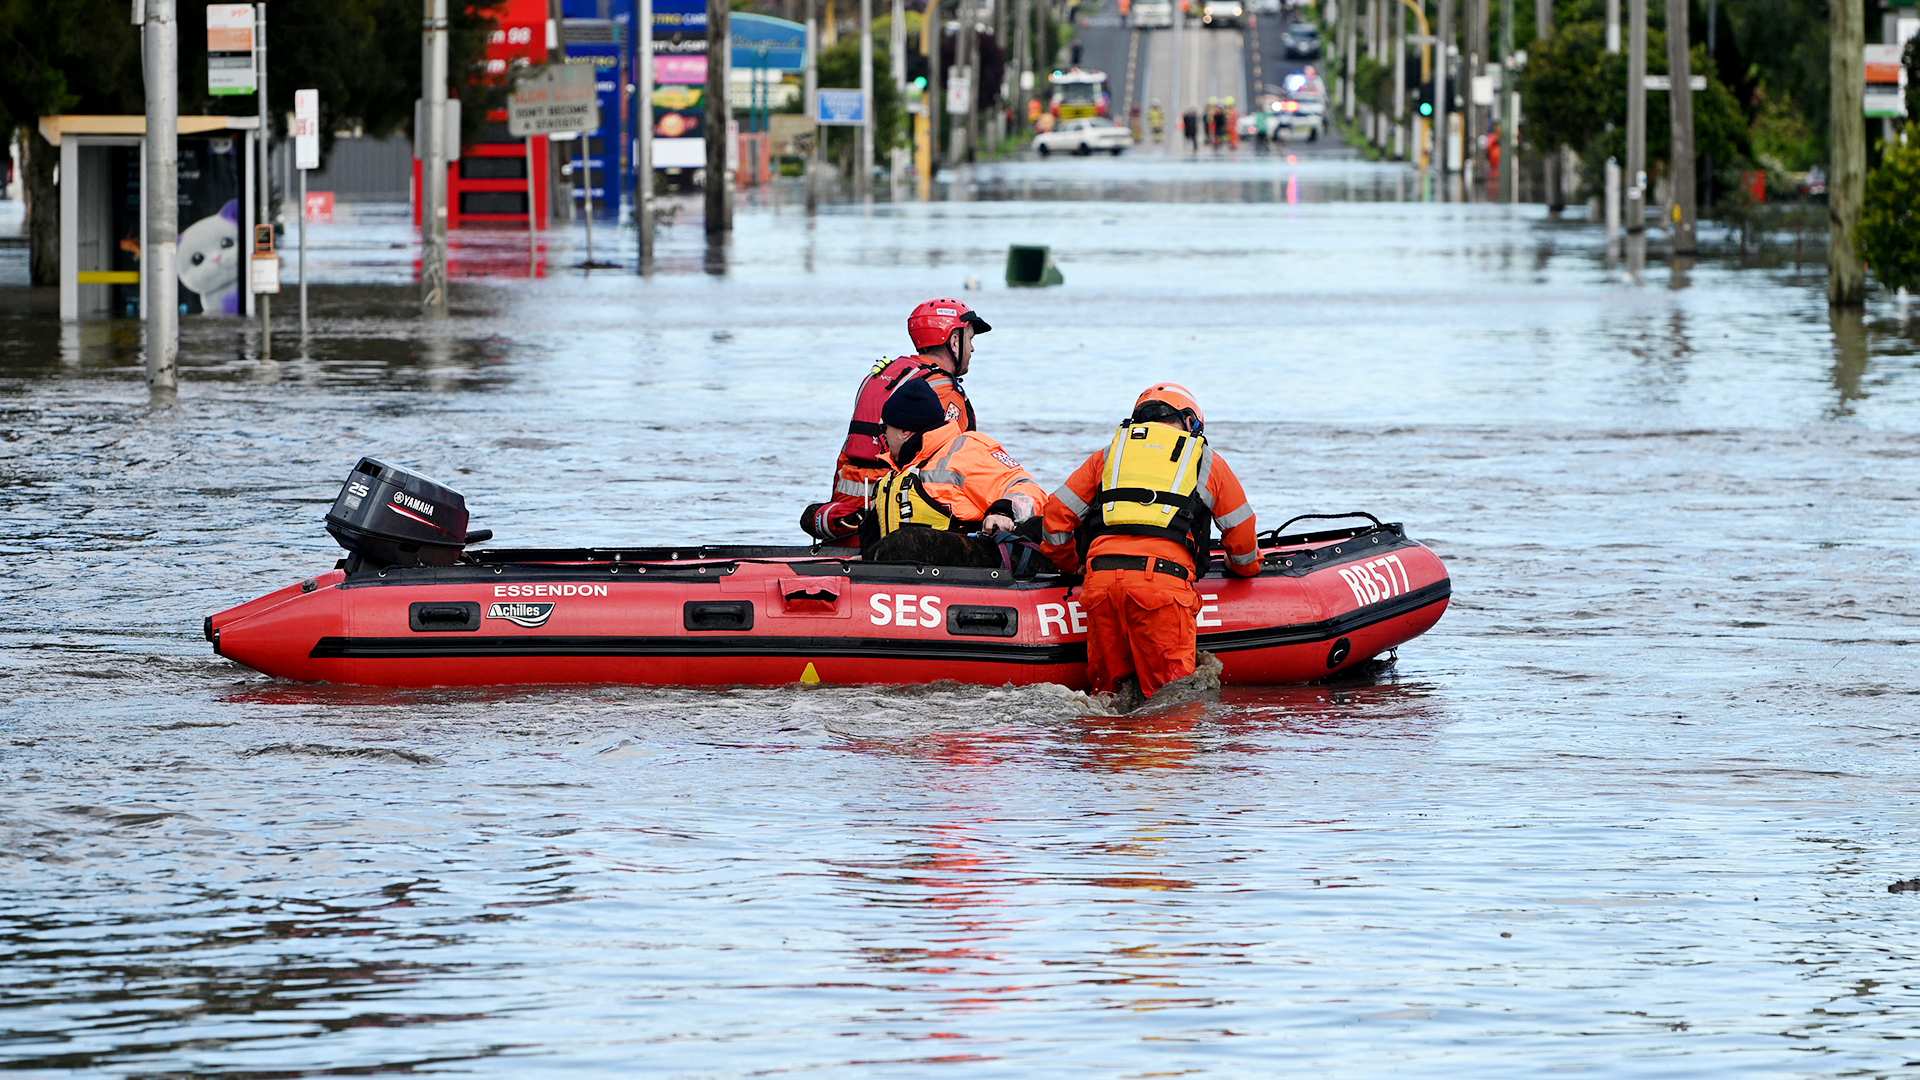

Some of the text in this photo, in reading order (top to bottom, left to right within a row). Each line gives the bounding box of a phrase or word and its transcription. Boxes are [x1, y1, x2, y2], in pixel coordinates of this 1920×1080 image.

[348, 481, 369, 497] 25
[403, 495, 434, 516] YAMAHA
[1338, 554, 1411, 607] RB577
[494, 584, 608, 597] ESSENDON
[489, 604, 540, 617] Achilles
[869, 592, 942, 628] SES
